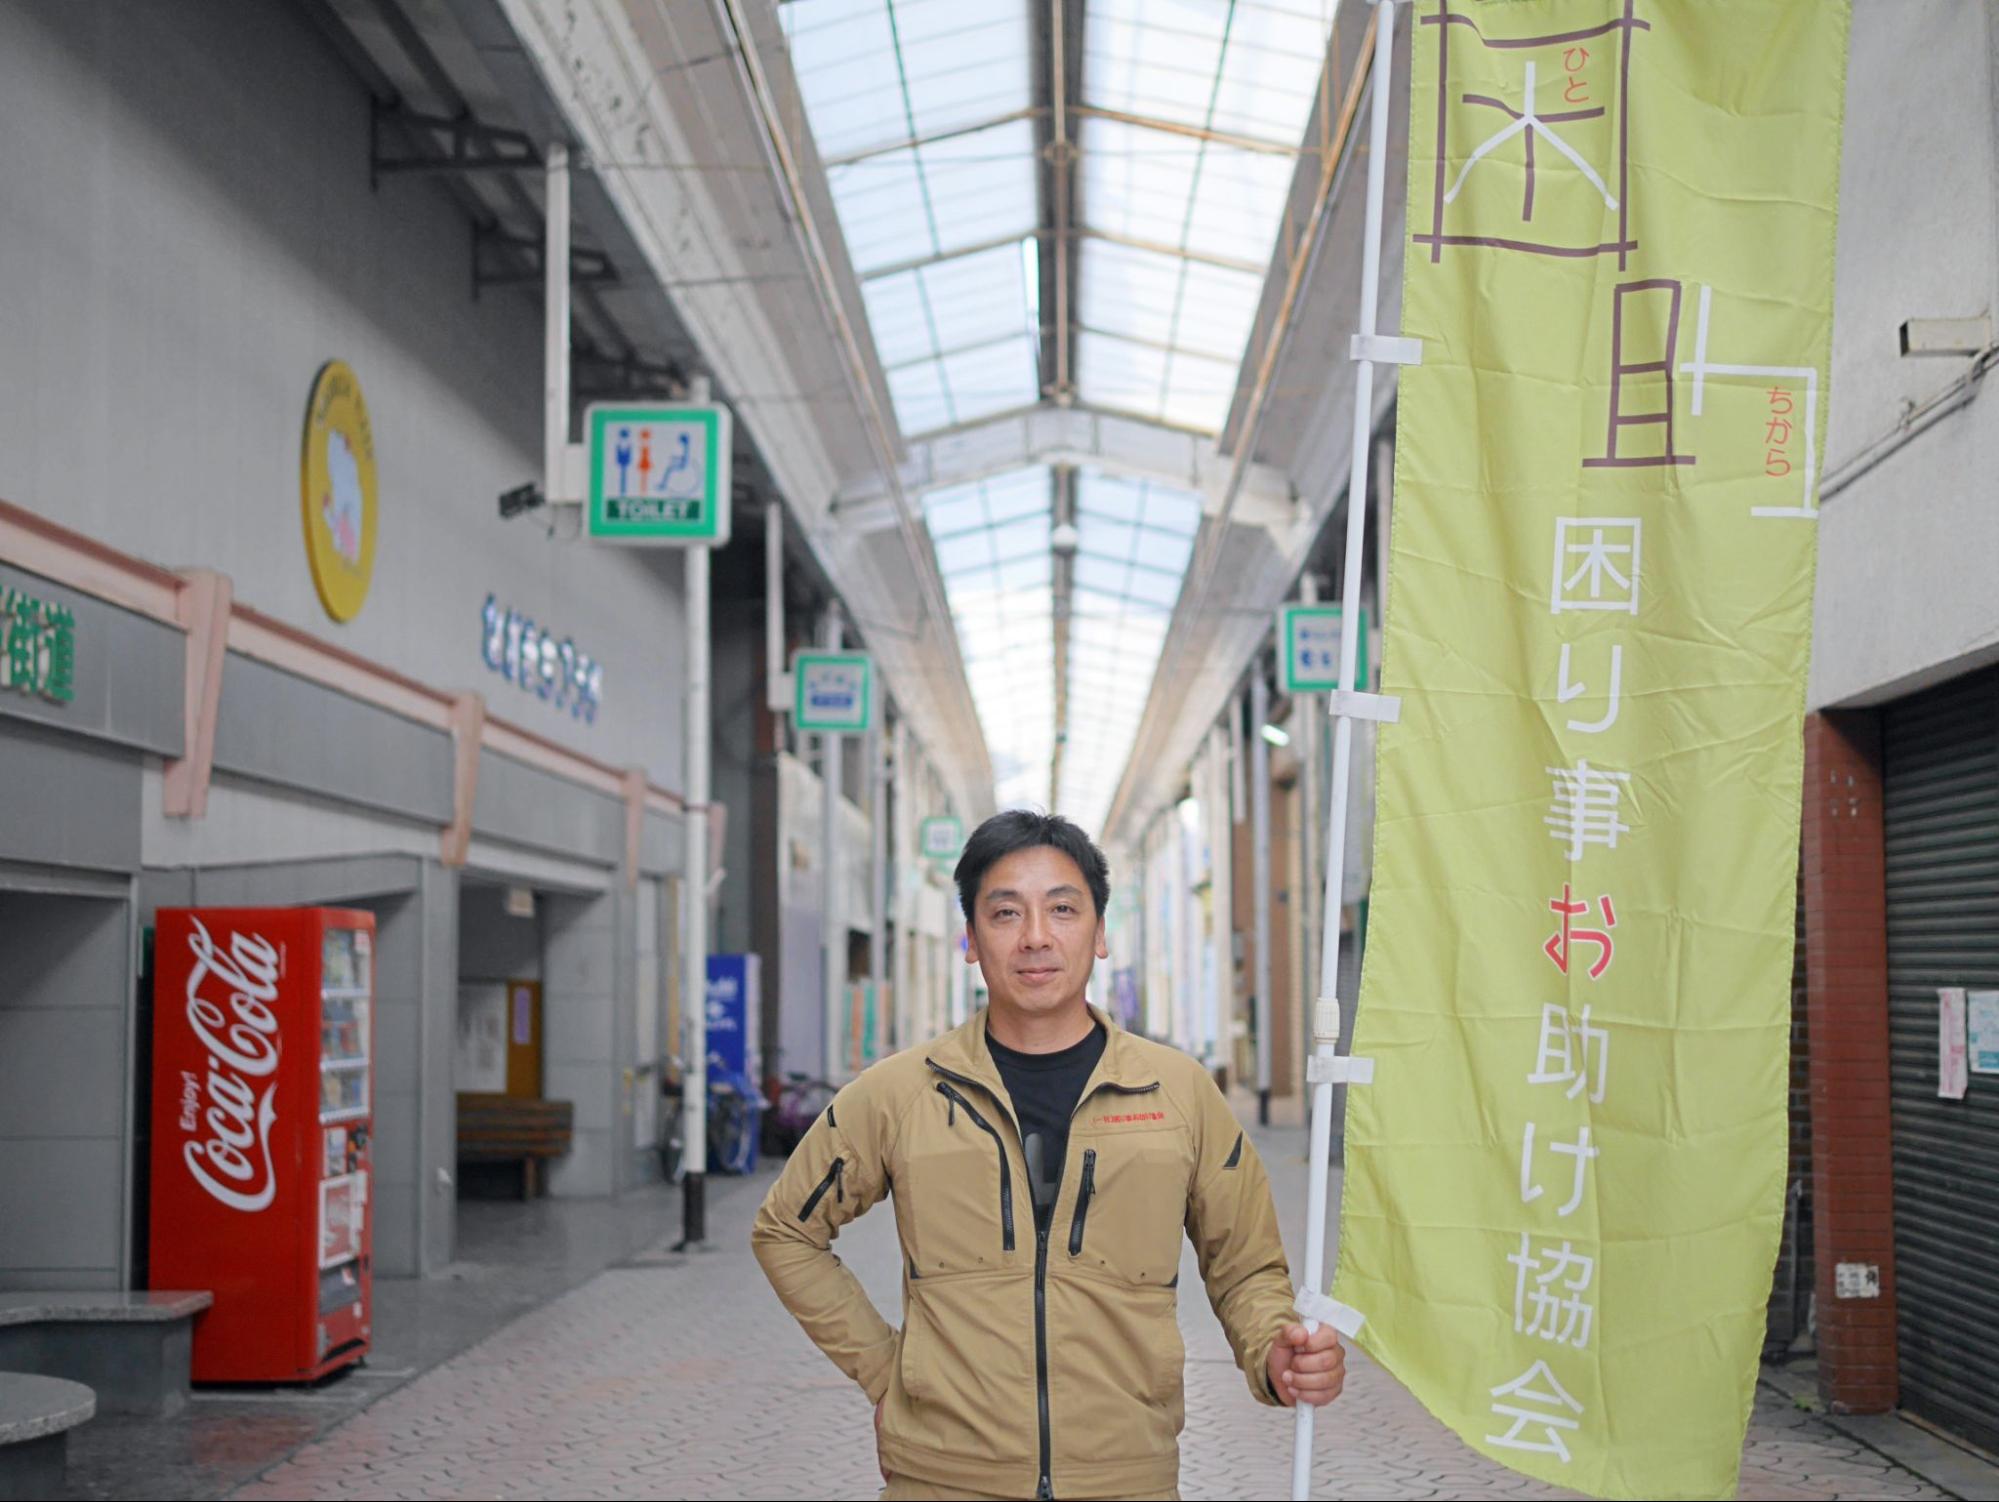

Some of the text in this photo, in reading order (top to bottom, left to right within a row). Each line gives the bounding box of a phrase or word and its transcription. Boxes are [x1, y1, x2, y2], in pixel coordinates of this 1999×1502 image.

[1562, 46, 1590, 104] ひと
[1764, 385, 1793, 477] ちから
[617, 498, 689, 521] TOILET
[1485, 515, 1643, 1463] 困り事お助け協会
[179, 1070, 201, 1132] Enjoy!
[184, 914, 280, 1212] Coca-Cola
